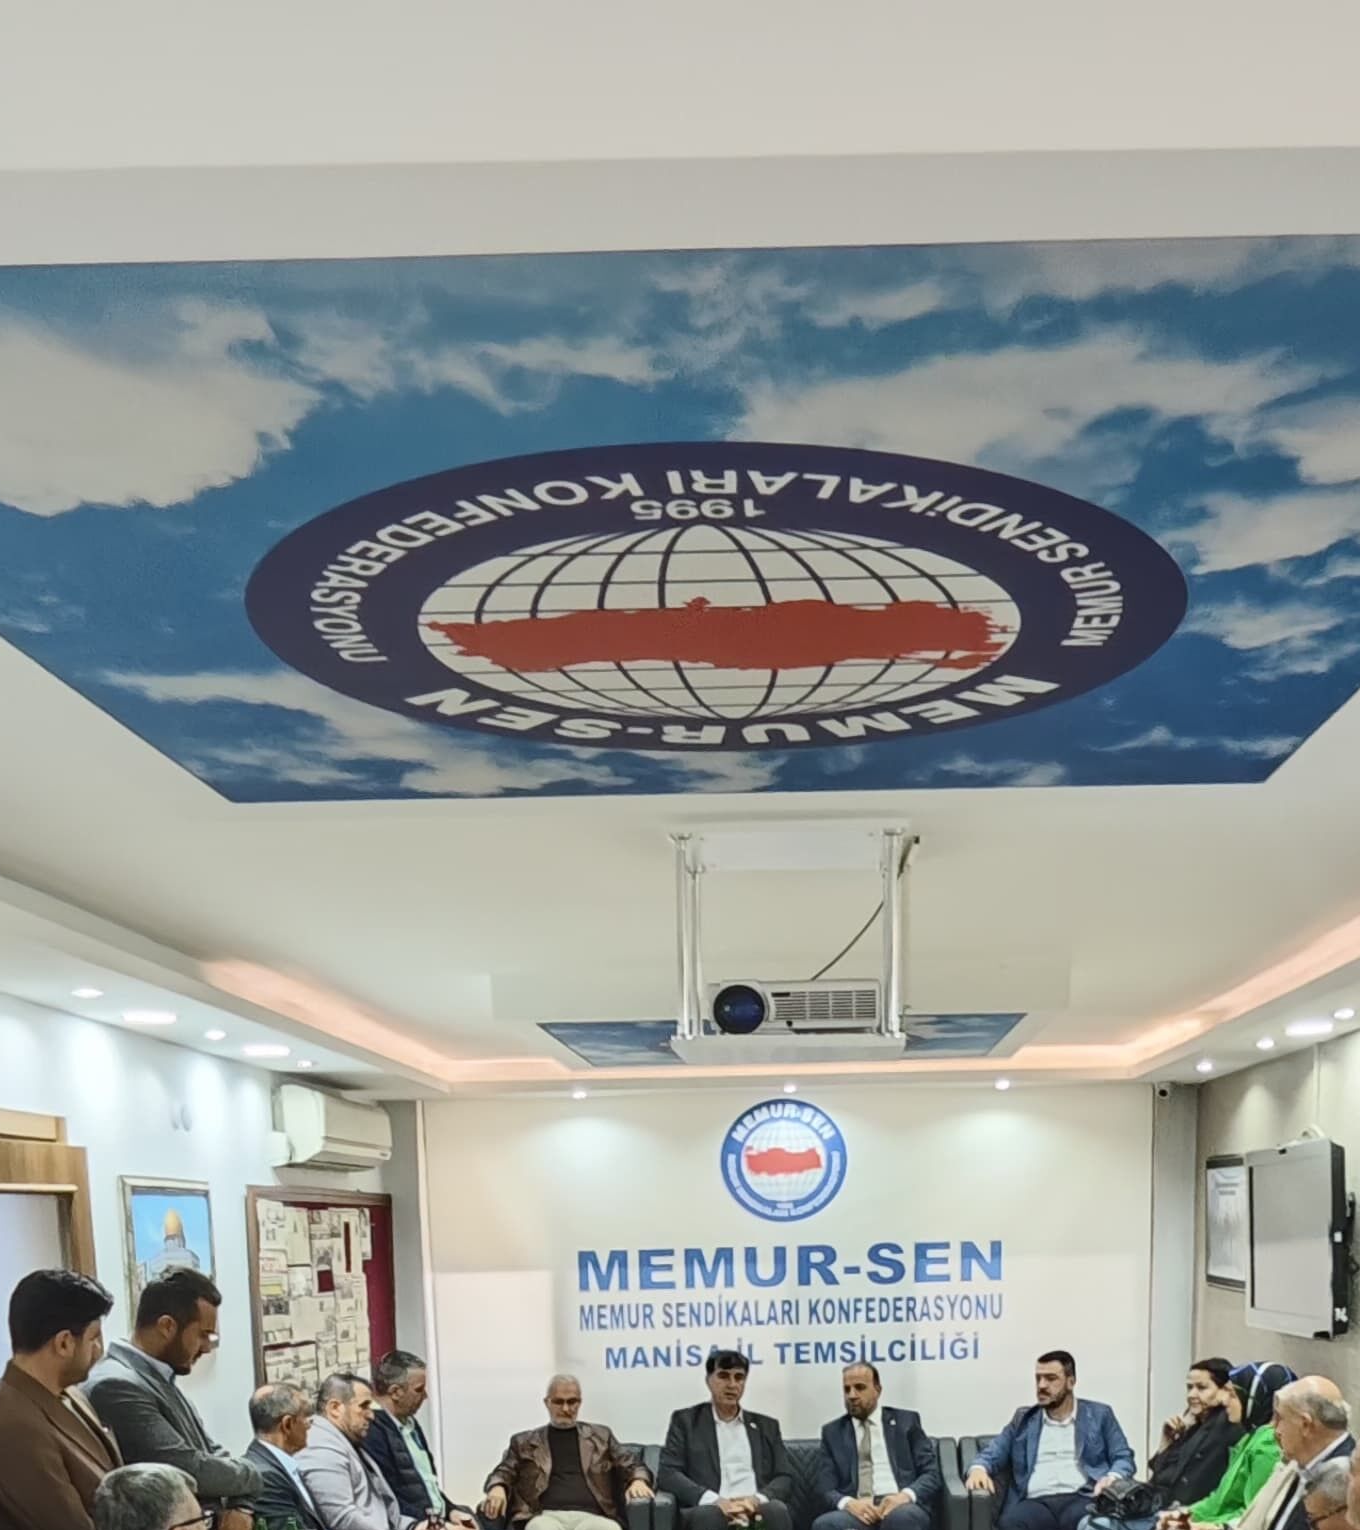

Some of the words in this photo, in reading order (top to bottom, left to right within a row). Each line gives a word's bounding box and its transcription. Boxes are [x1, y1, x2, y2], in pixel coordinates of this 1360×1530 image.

[630, 499, 766, 520] 1995
[310, 472, 644, 662] KONFEDERASYONU
[1060, 562, 1123, 646] MEMUR
[405, 675, 1061, 744] MEMUR-SEN
[577, 1240, 1002, 1291] MEMUR-SEN
[579, 1303, 655, 1331] MEMUR
[662, 1294, 800, 1328] SENDİKALARI
[808, 1293, 1003, 1325] KONFEDERASYONU
[774, 1331, 979, 1364] TEMSİLCİLİĞİ
